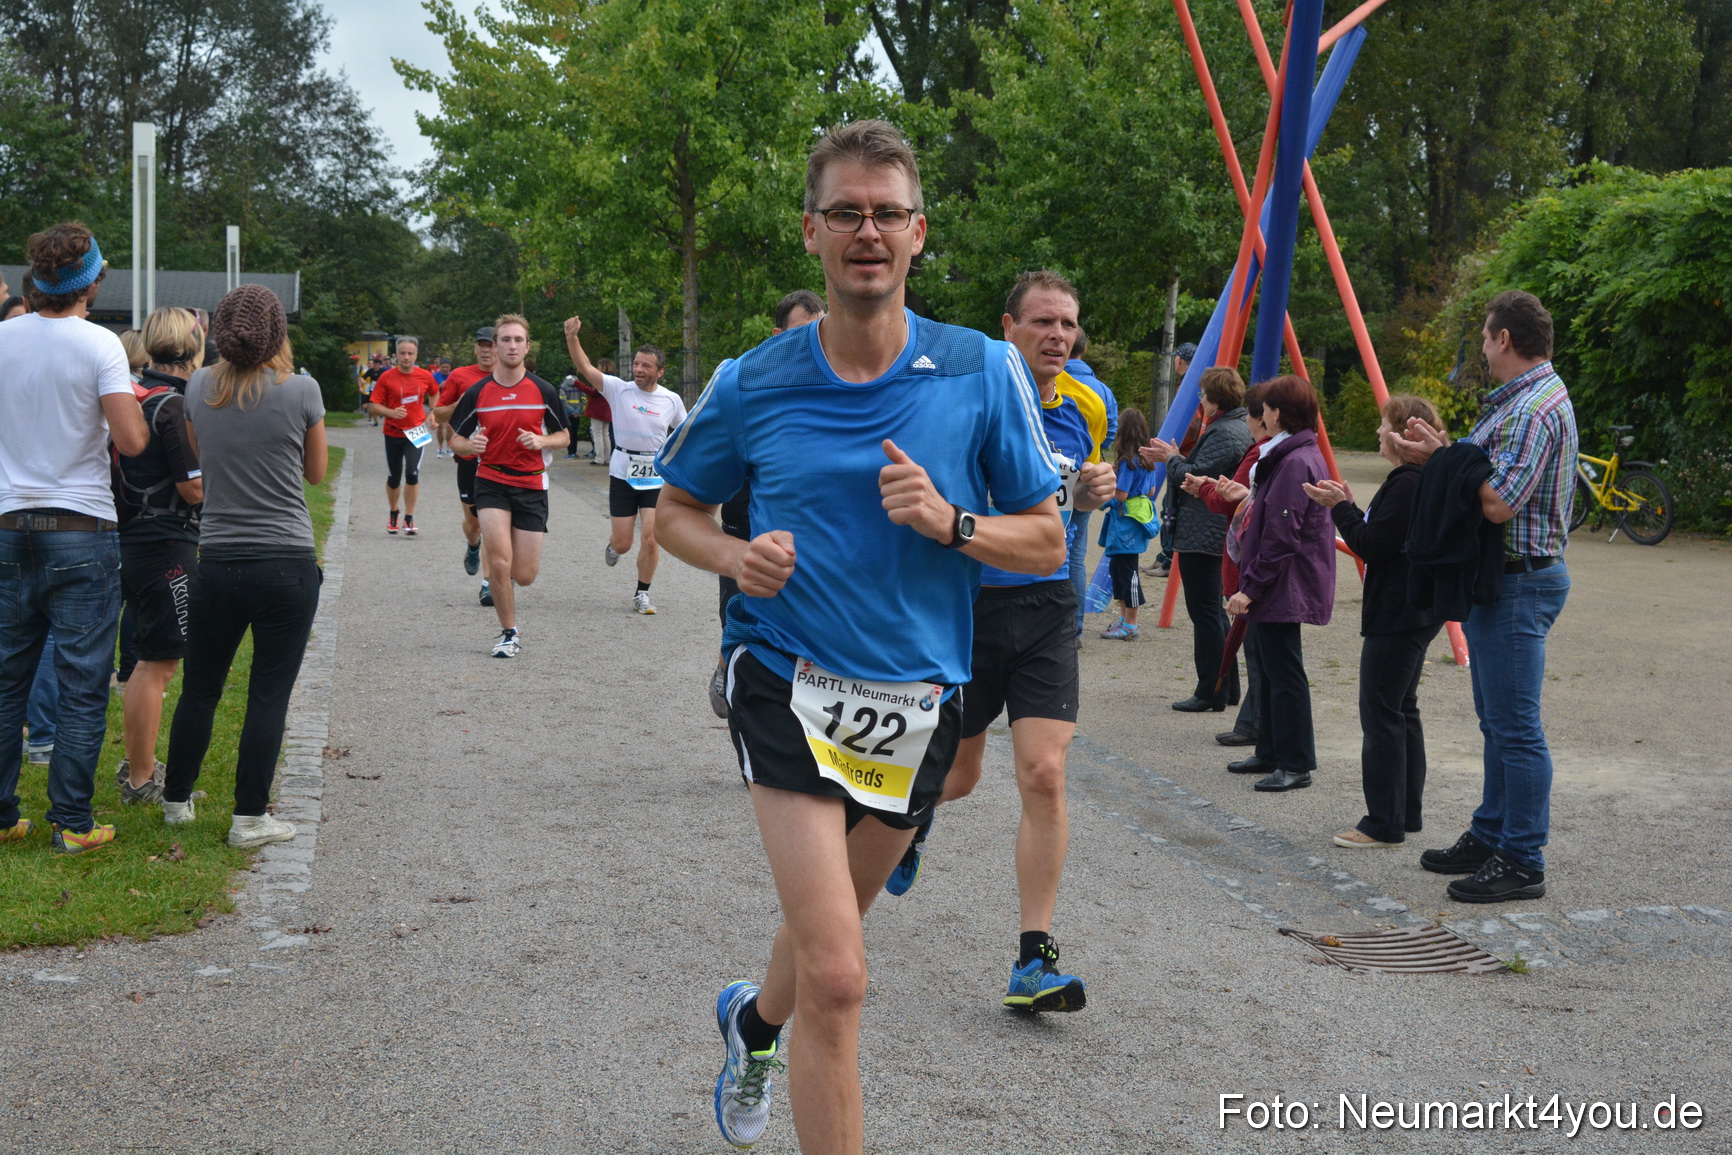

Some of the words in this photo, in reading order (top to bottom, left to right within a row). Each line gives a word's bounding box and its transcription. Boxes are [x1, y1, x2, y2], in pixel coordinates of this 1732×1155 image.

[797, 672, 846, 693] PARTL
[851, 683, 915, 707] Neumarkt
[822, 701, 907, 757] 122
